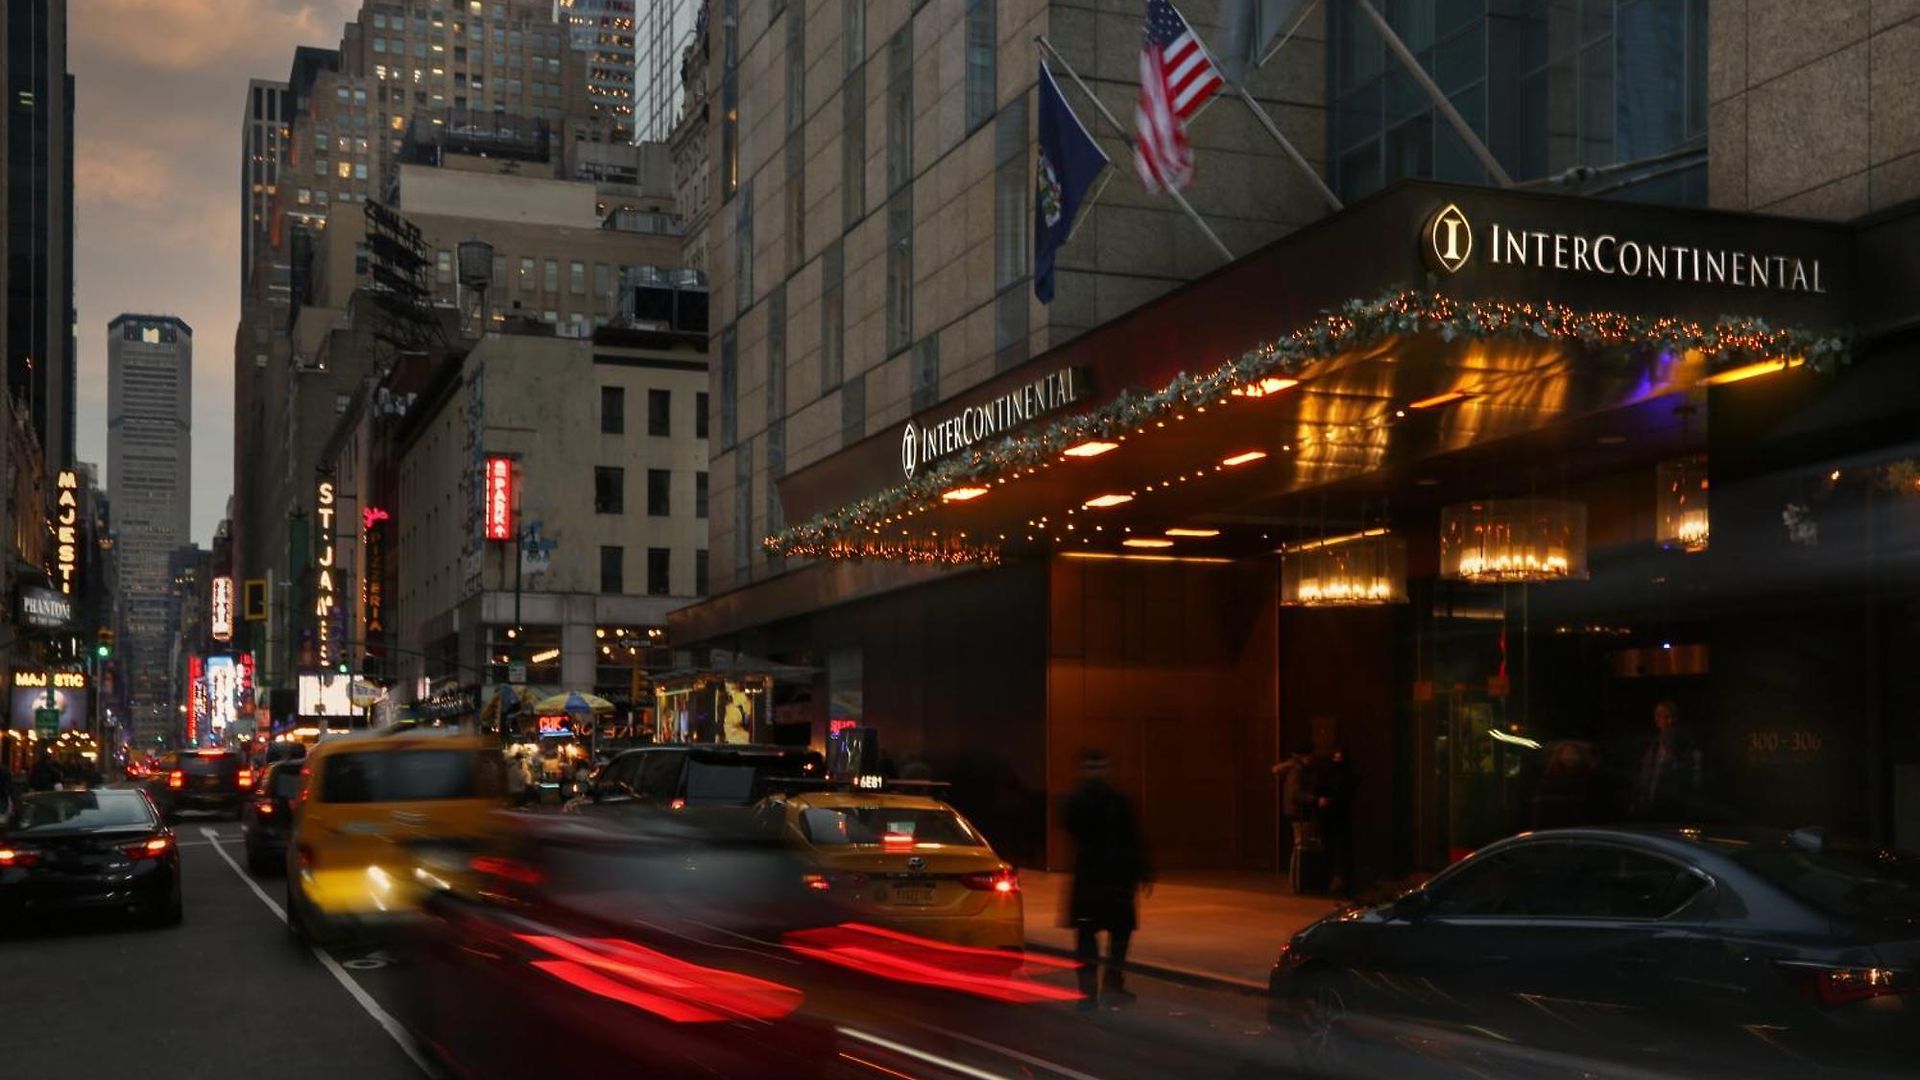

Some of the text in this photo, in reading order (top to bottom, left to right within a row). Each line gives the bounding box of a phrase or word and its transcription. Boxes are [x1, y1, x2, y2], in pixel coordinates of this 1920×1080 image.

[1491, 223, 1827, 295] INTERCONTINENTAL
[922, 366, 1077, 463] INTERCONTINENTAL
[493, 477, 507, 525] PARK
[58, 470, 77, 595] MAJESTI
[23, 596, 71, 621] PHANTOM
[15, 672, 84, 688] MAJSTIC
